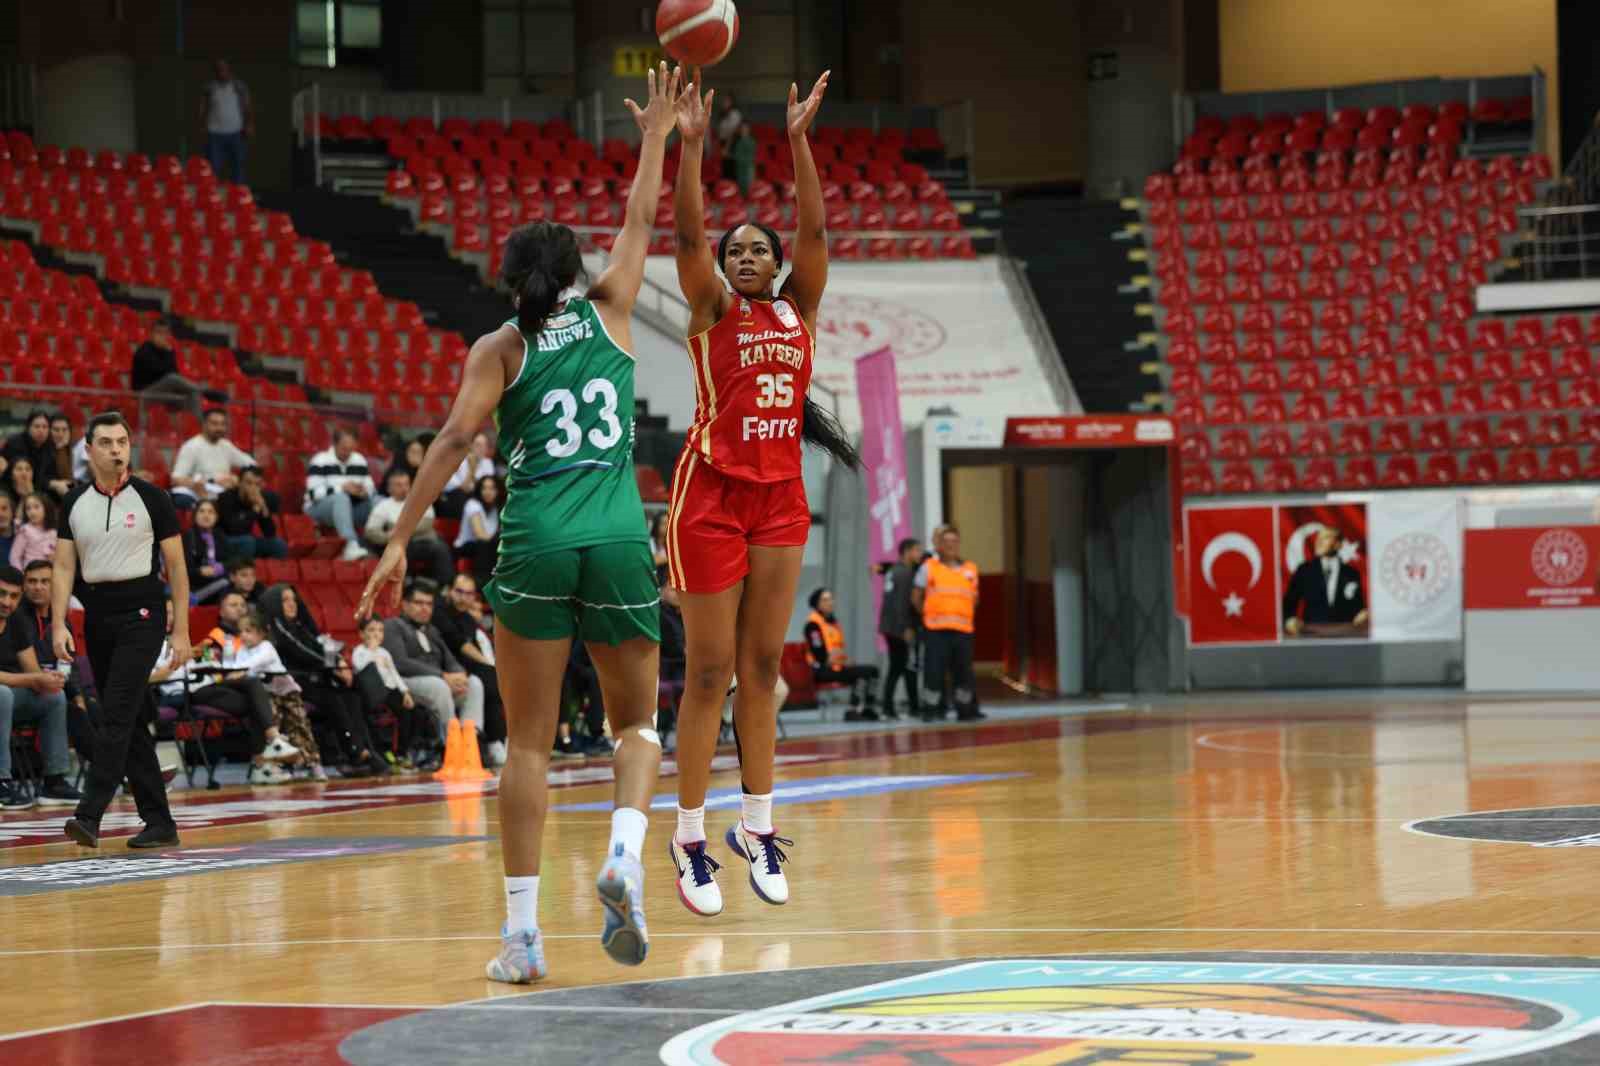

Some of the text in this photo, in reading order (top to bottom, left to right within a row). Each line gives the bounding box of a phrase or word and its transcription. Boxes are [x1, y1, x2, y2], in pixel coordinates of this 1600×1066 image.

[537, 319, 594, 351] ANIGWE
[739, 343, 804, 370] KAYSERI
[755, 373, 794, 409] 35
[541, 378, 622, 457] 33
[742, 415, 798, 442] Ferre
